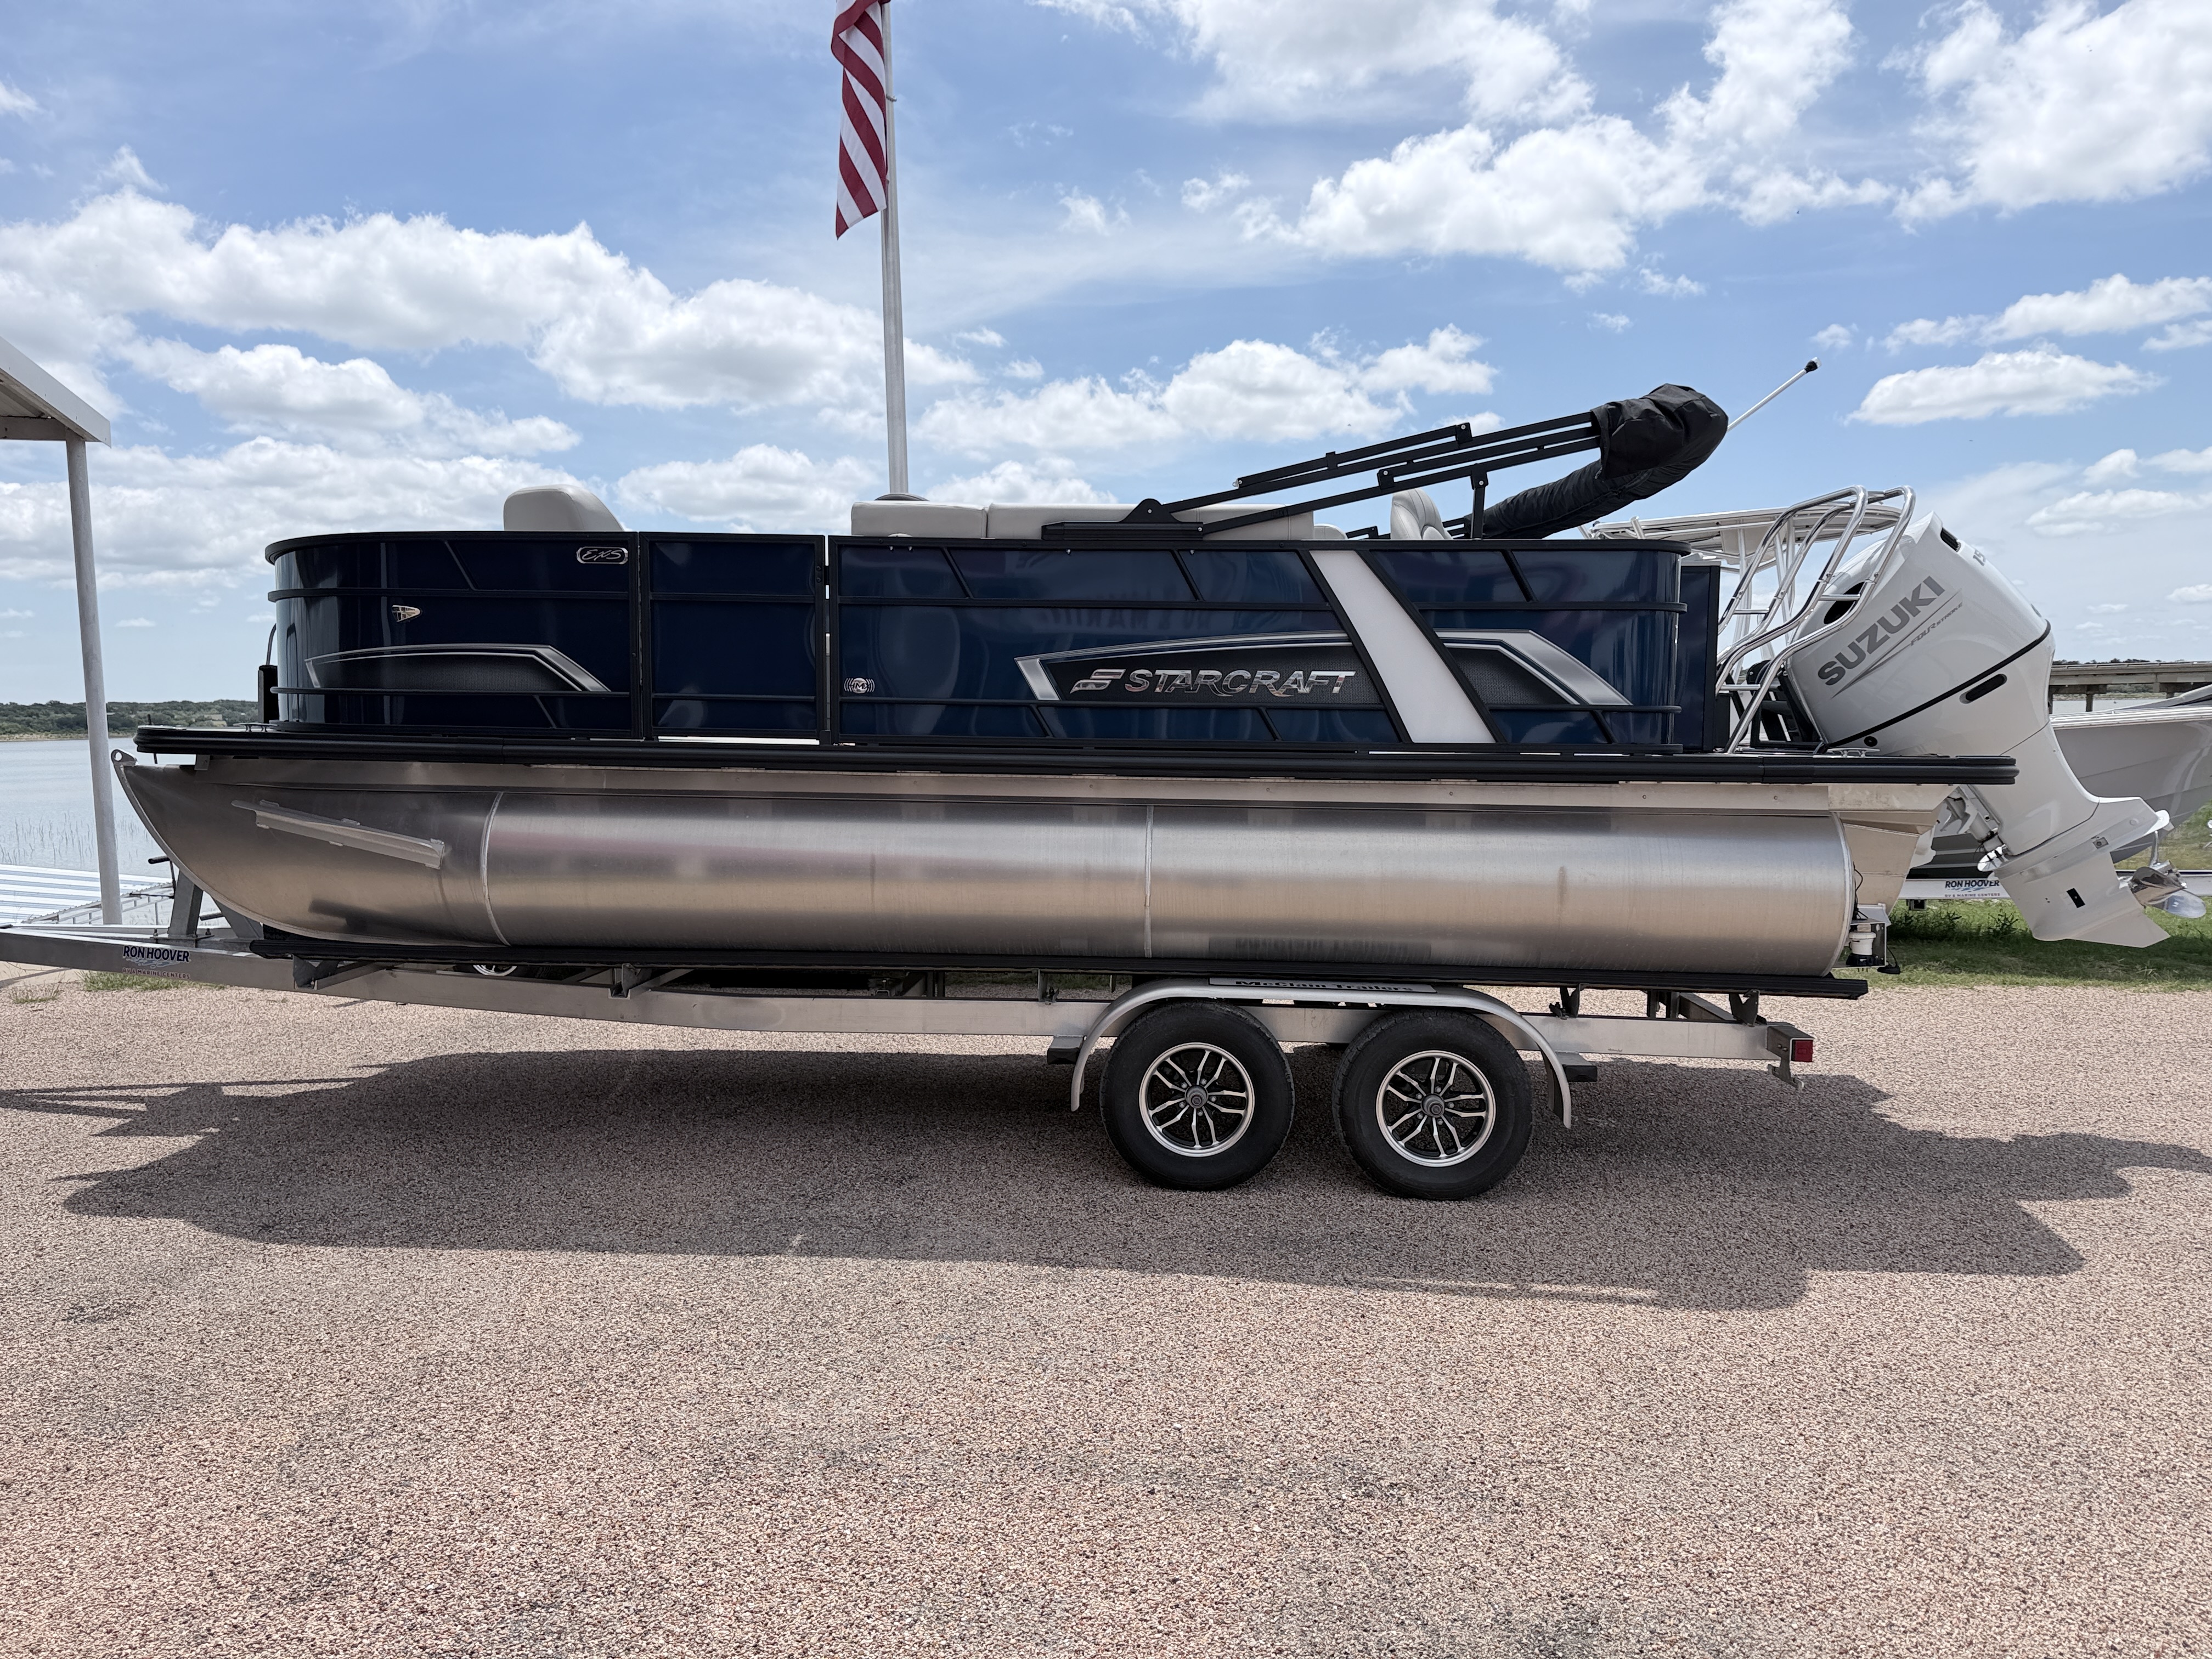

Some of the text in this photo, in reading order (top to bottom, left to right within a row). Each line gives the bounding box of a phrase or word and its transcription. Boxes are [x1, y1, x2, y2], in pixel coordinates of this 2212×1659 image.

[582, 549, 622, 561] EXS
[1818, 575, 1945, 686] SUZUKI
[1125, 669, 1356, 697] STARCRAFT
[123, 945, 189, 962] RON HOOVER
